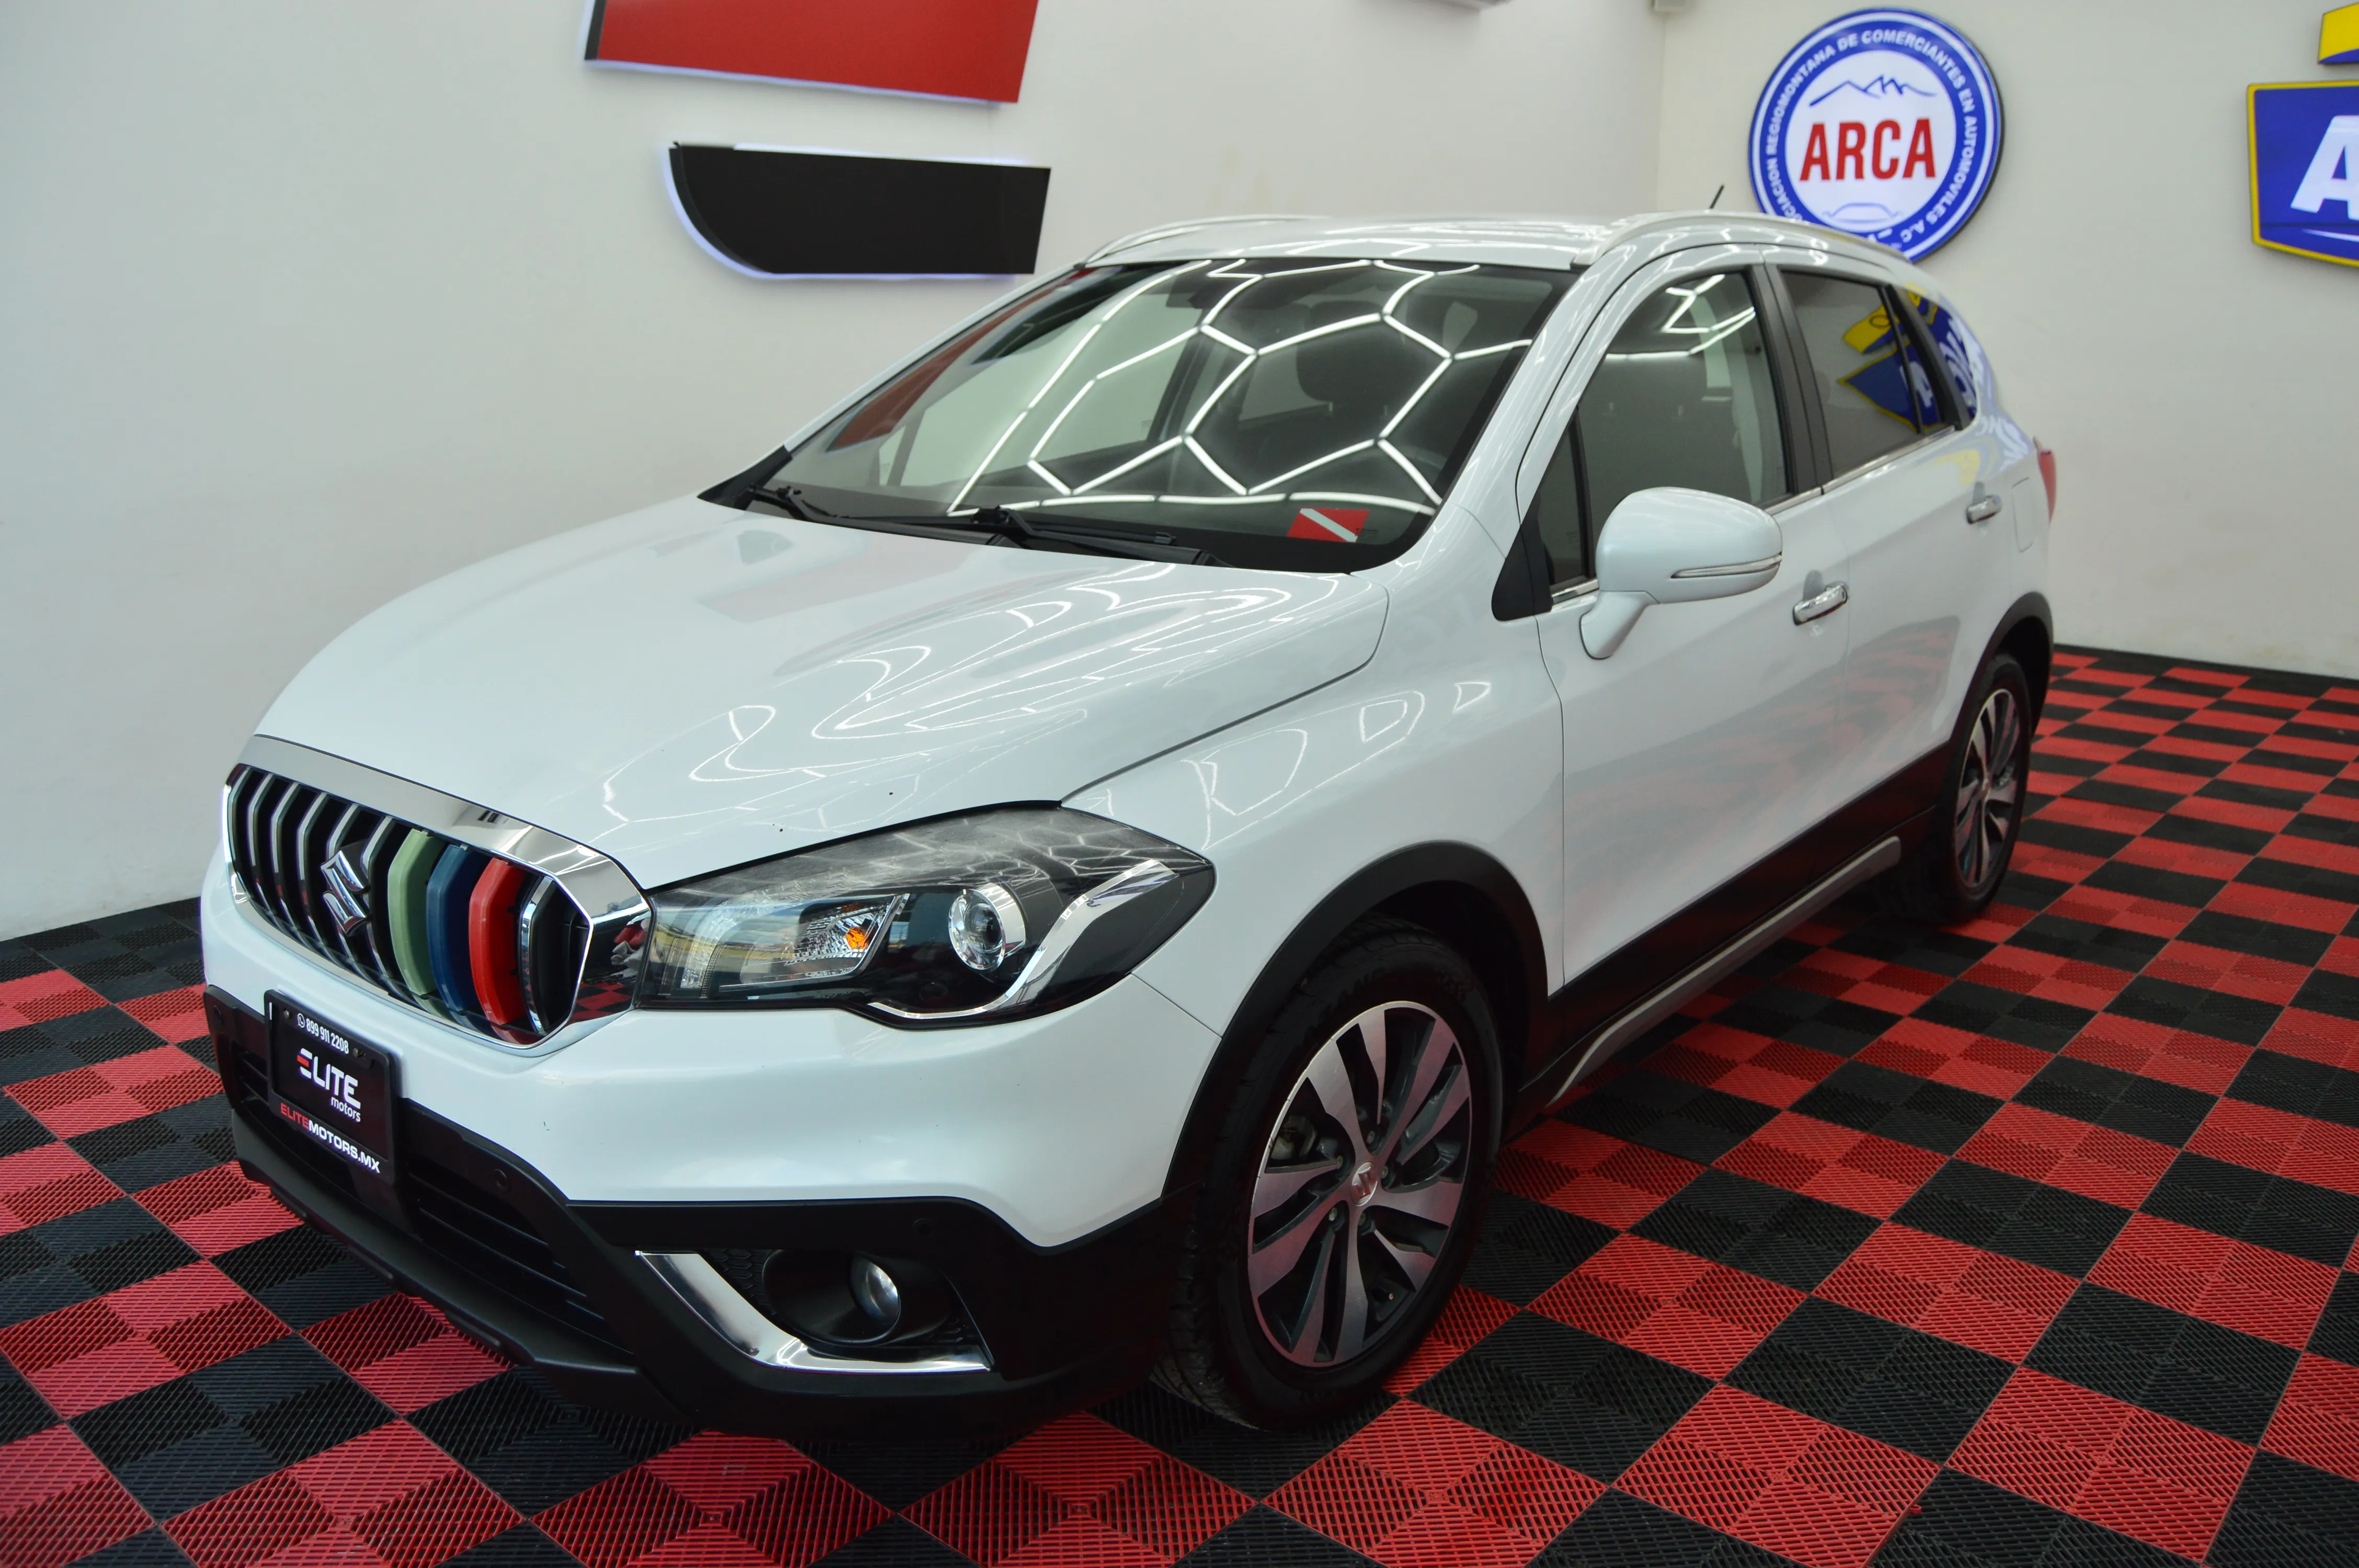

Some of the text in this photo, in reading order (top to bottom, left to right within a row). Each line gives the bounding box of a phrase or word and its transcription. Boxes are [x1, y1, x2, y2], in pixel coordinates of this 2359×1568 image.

[1837, 33, 1859, 51] DE
[1861, 29, 1966, 89] COMERCIANTES
[1958, 88, 1975, 113] EN
[1800, 118, 1936, 181] ARCA
[1926, 115, 1978, 224] AUTOMOVILES
[306, 1018, 349, 1054] 899 911 2208
[296, 1048, 361, 1109] ELITE
[280, 1102, 380, 1174] ELITEMOTORS.MX
[330, 1097, 361, 1122] motors
